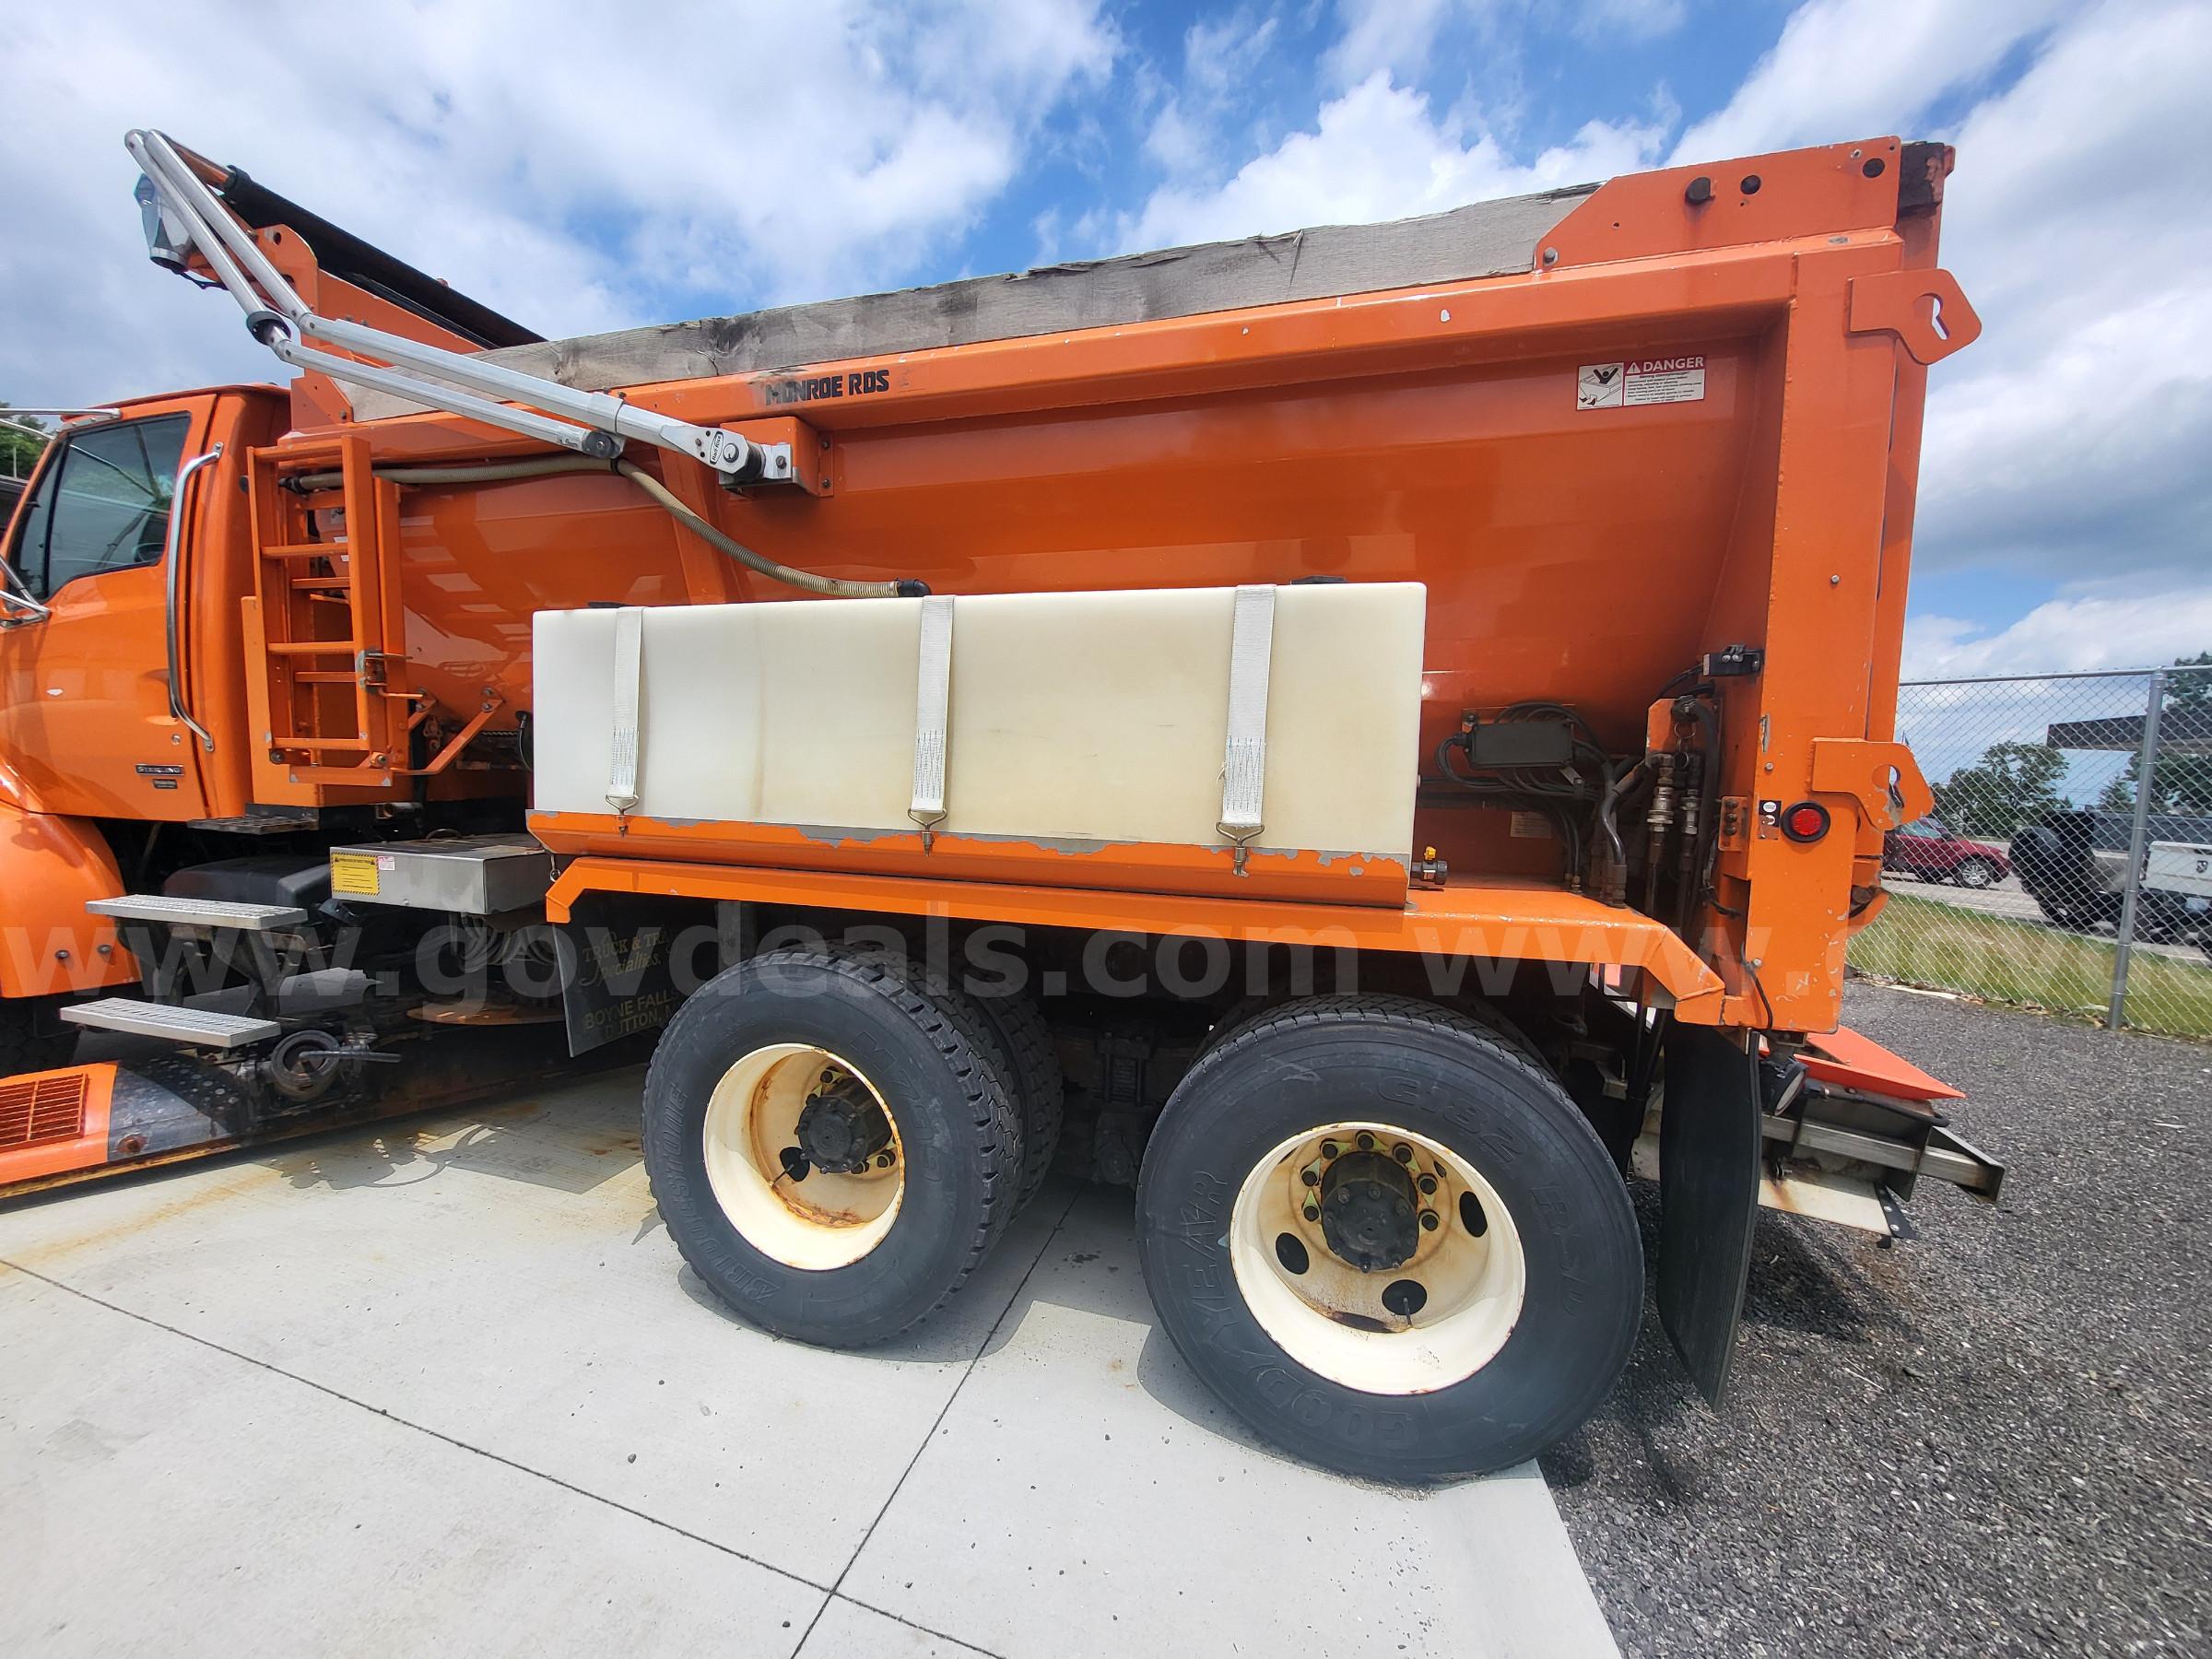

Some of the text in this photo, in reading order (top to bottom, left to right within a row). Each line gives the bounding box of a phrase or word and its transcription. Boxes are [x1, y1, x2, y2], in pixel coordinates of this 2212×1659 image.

[1642, 356, 1704, 372] DANGER
[766, 370, 890, 406] MONROE RDS
[582, 937, 629, 962] TRUCK
[631, 936, 641, 951] &
[583, 1000, 634, 1030] BOYNE
